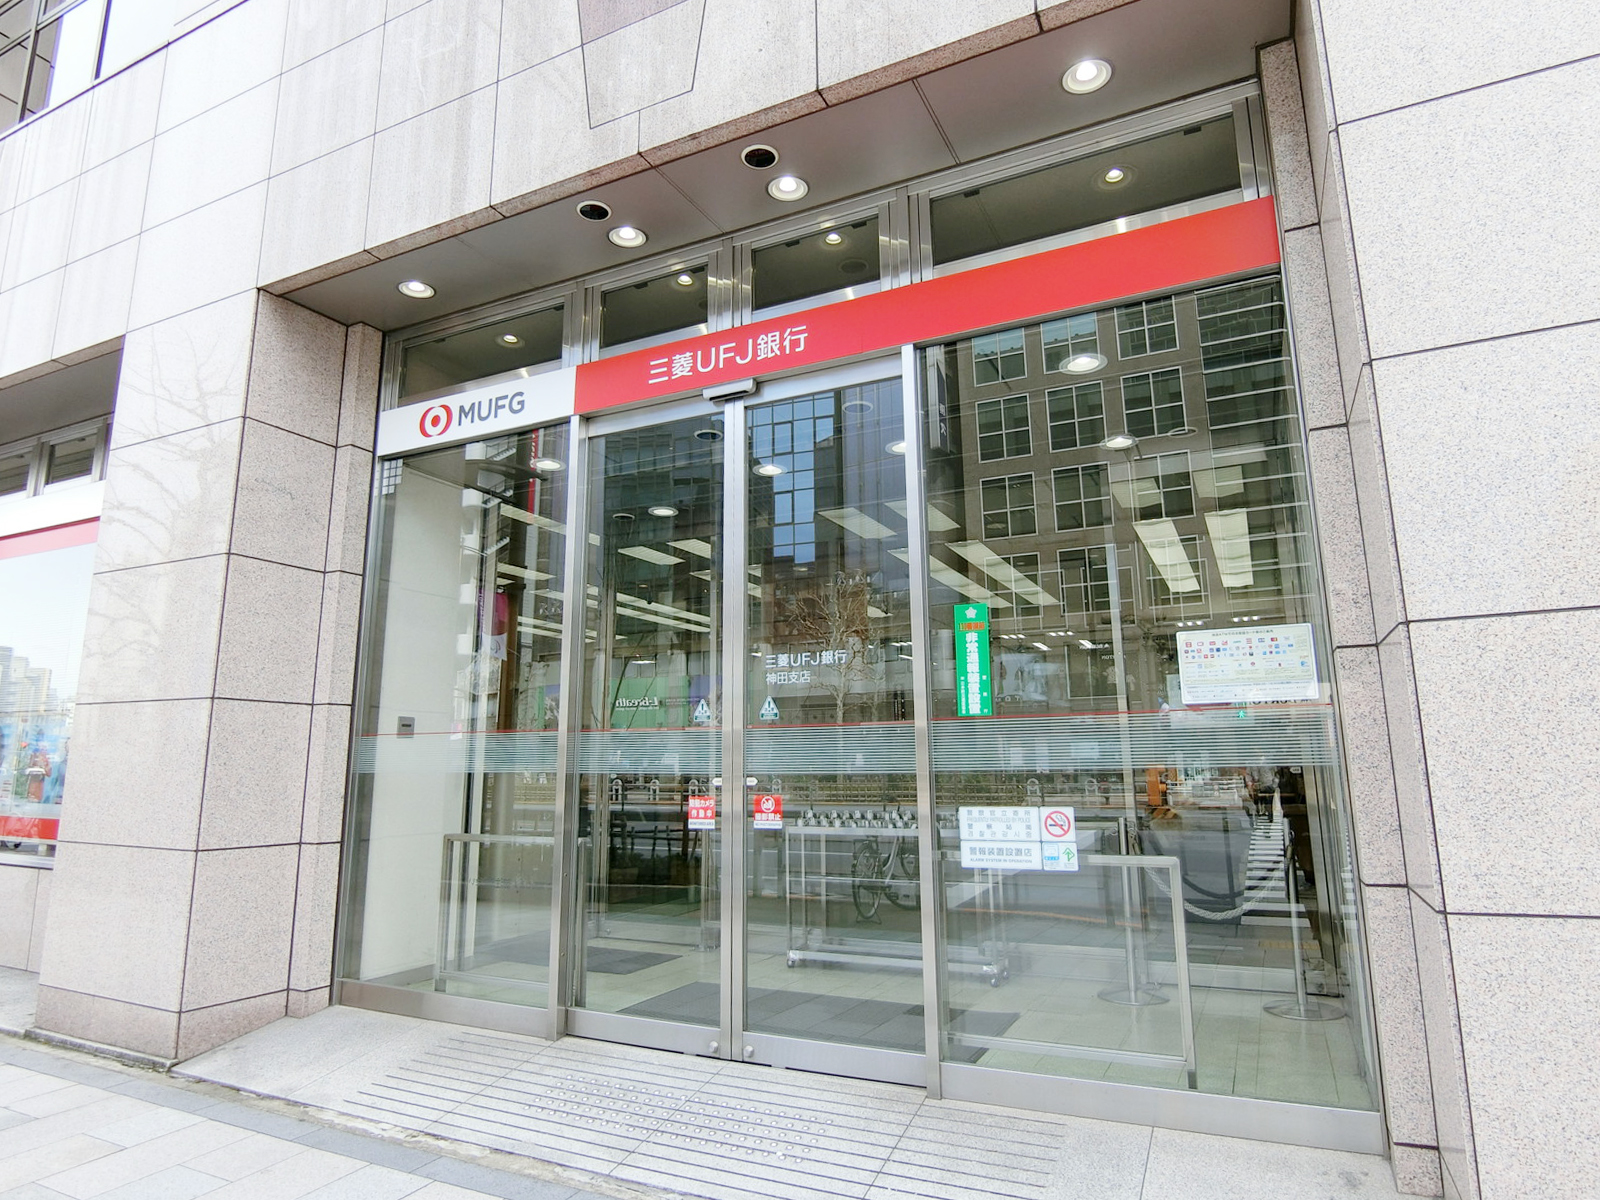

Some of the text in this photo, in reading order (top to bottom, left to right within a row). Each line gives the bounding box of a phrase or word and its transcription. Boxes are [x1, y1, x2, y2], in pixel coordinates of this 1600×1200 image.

[648, 325, 808, 384] 三菱UFJ銀行
[457, 391, 526, 427] MUFG
[765, 649, 848, 669] 三菱UFJ銀行
[765, 670, 811, 685] 神田支店
